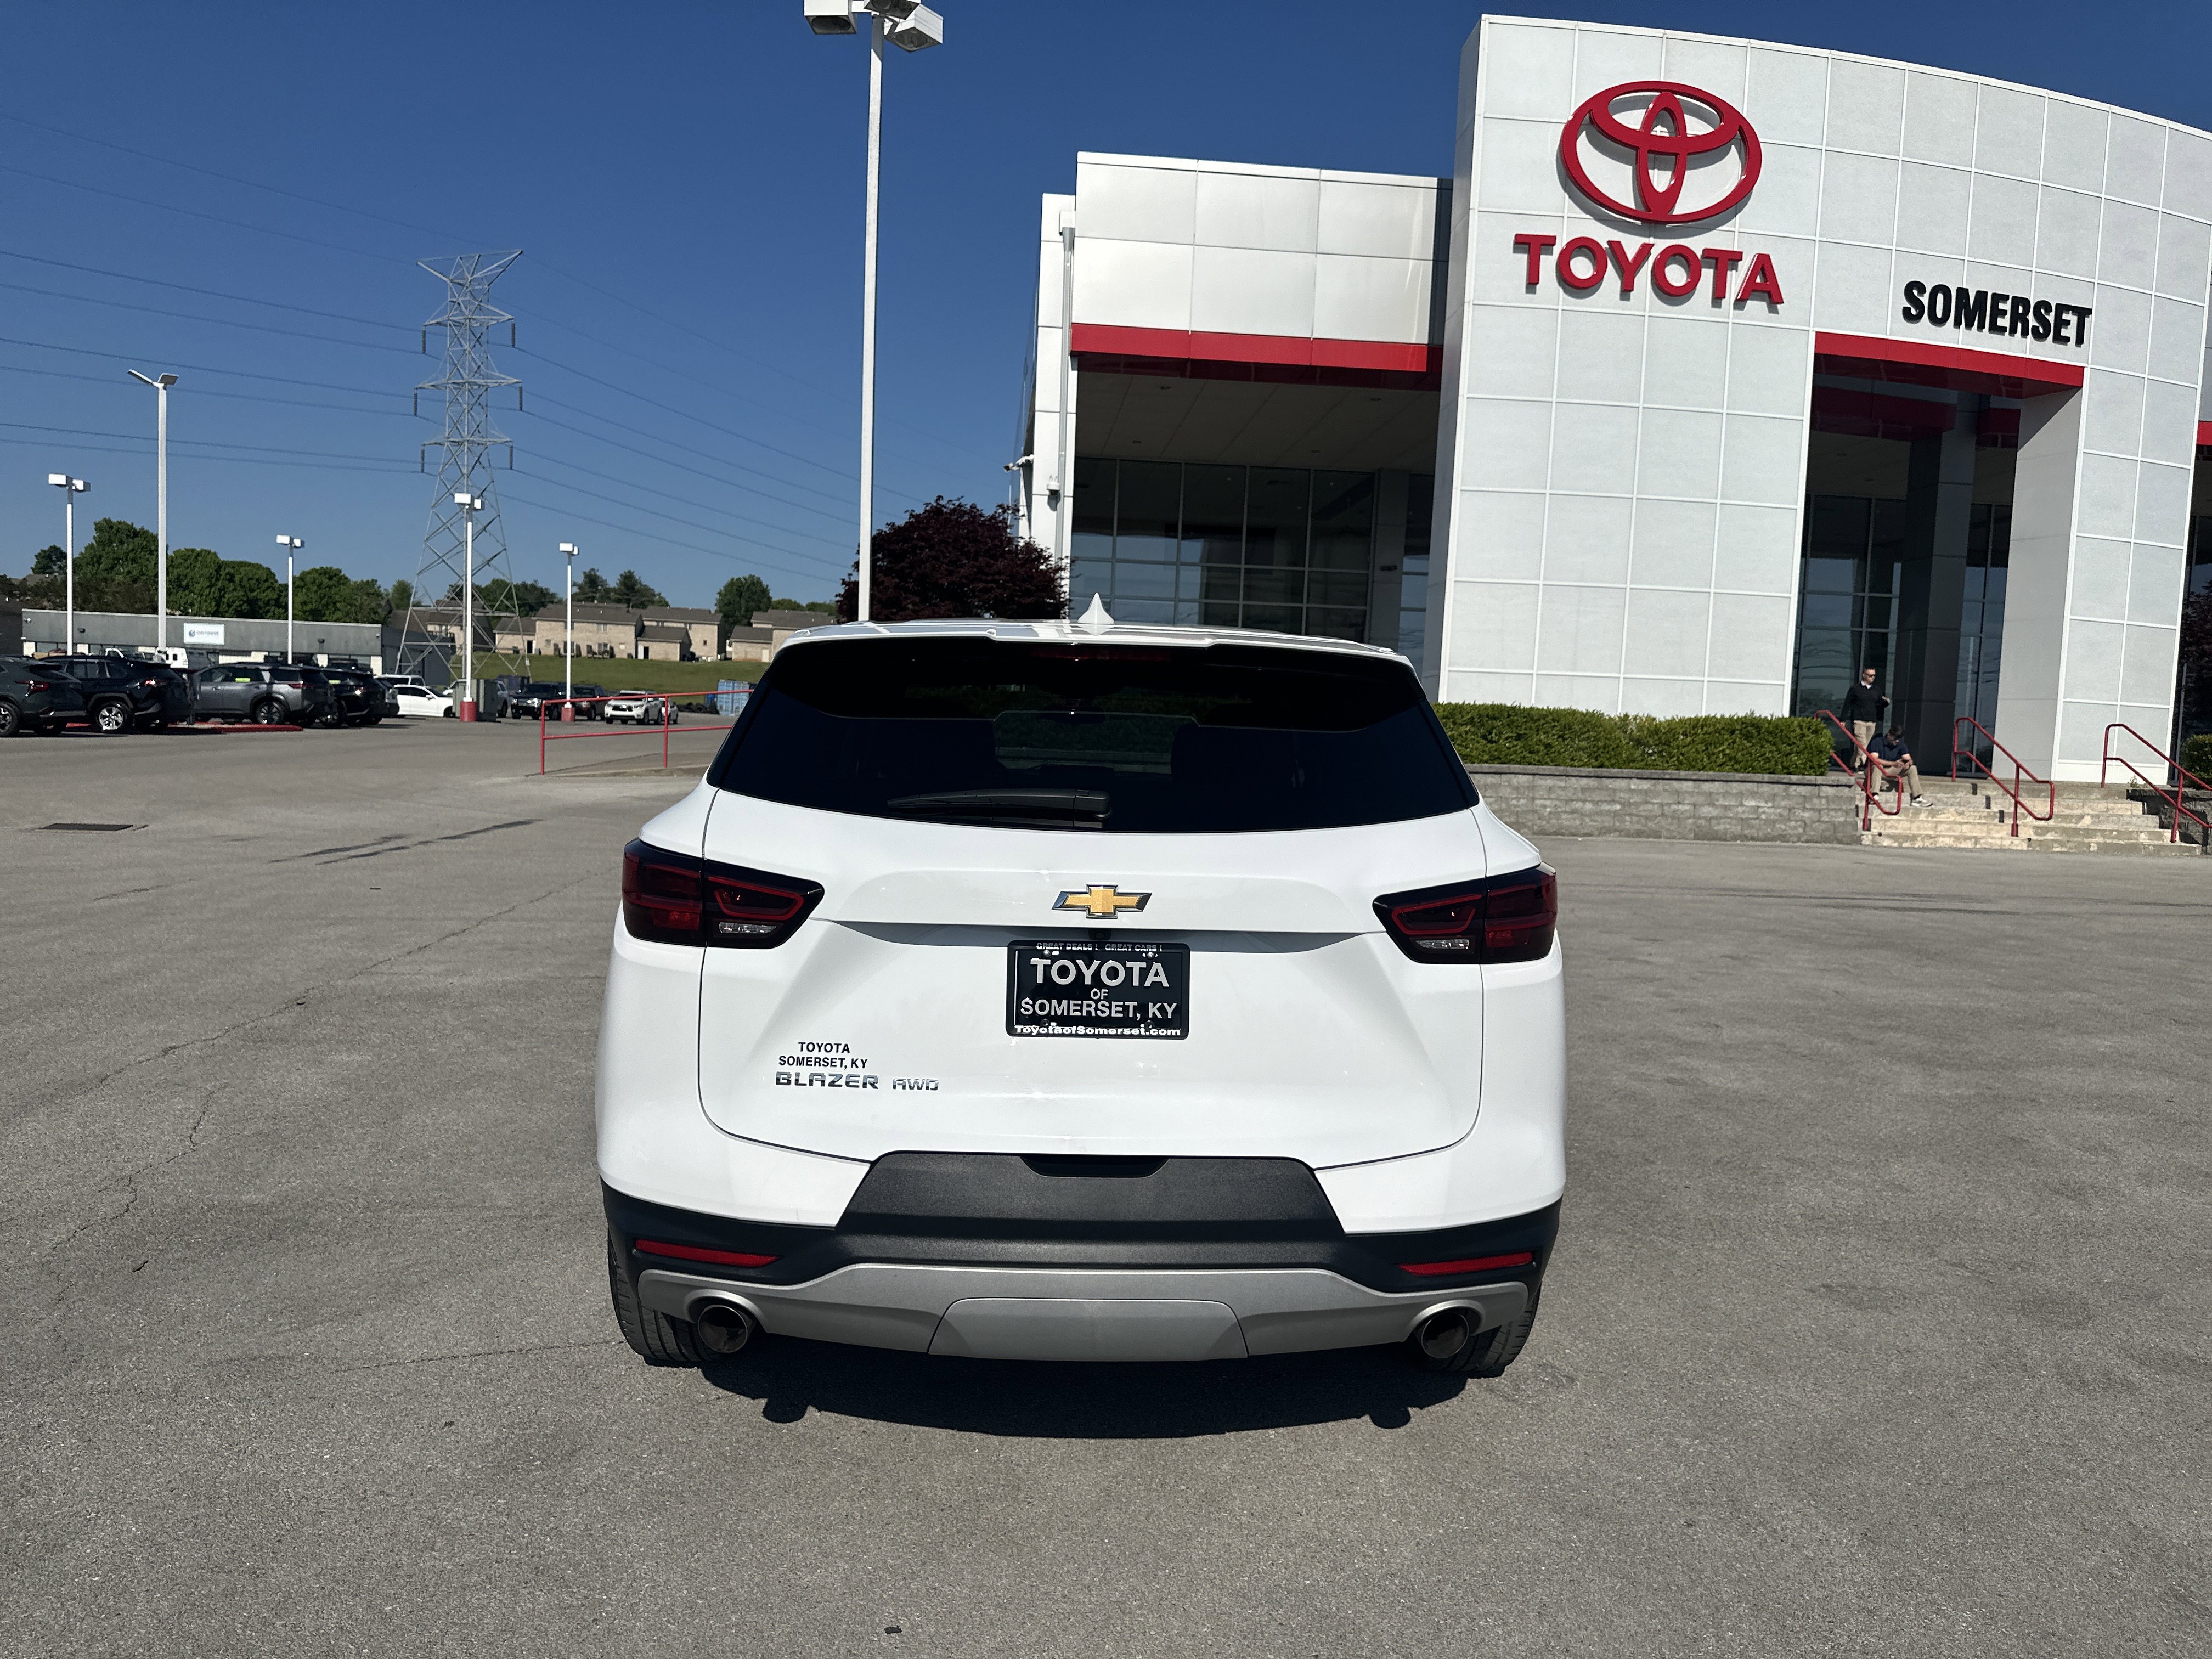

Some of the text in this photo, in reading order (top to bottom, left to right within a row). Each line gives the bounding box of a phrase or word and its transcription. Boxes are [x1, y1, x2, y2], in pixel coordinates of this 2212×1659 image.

[1514, 233, 1785, 306] TOYOTA
[1901, 280, 2092, 347] SOMERSET
[1030, 958, 1170, 987] TOYOTA
[1091, 988, 1109, 1000] OF
[1020, 998, 1177, 1020] SOMERSET, KY
[1014, 1025, 1181, 1036] ToyotaofSomerset.com
[798, 1042, 850, 1053] TOYOTA
[778, 1056, 868, 1070] SOMERSET, KY
[776, 1071, 939, 1091] BLAZER AWD
